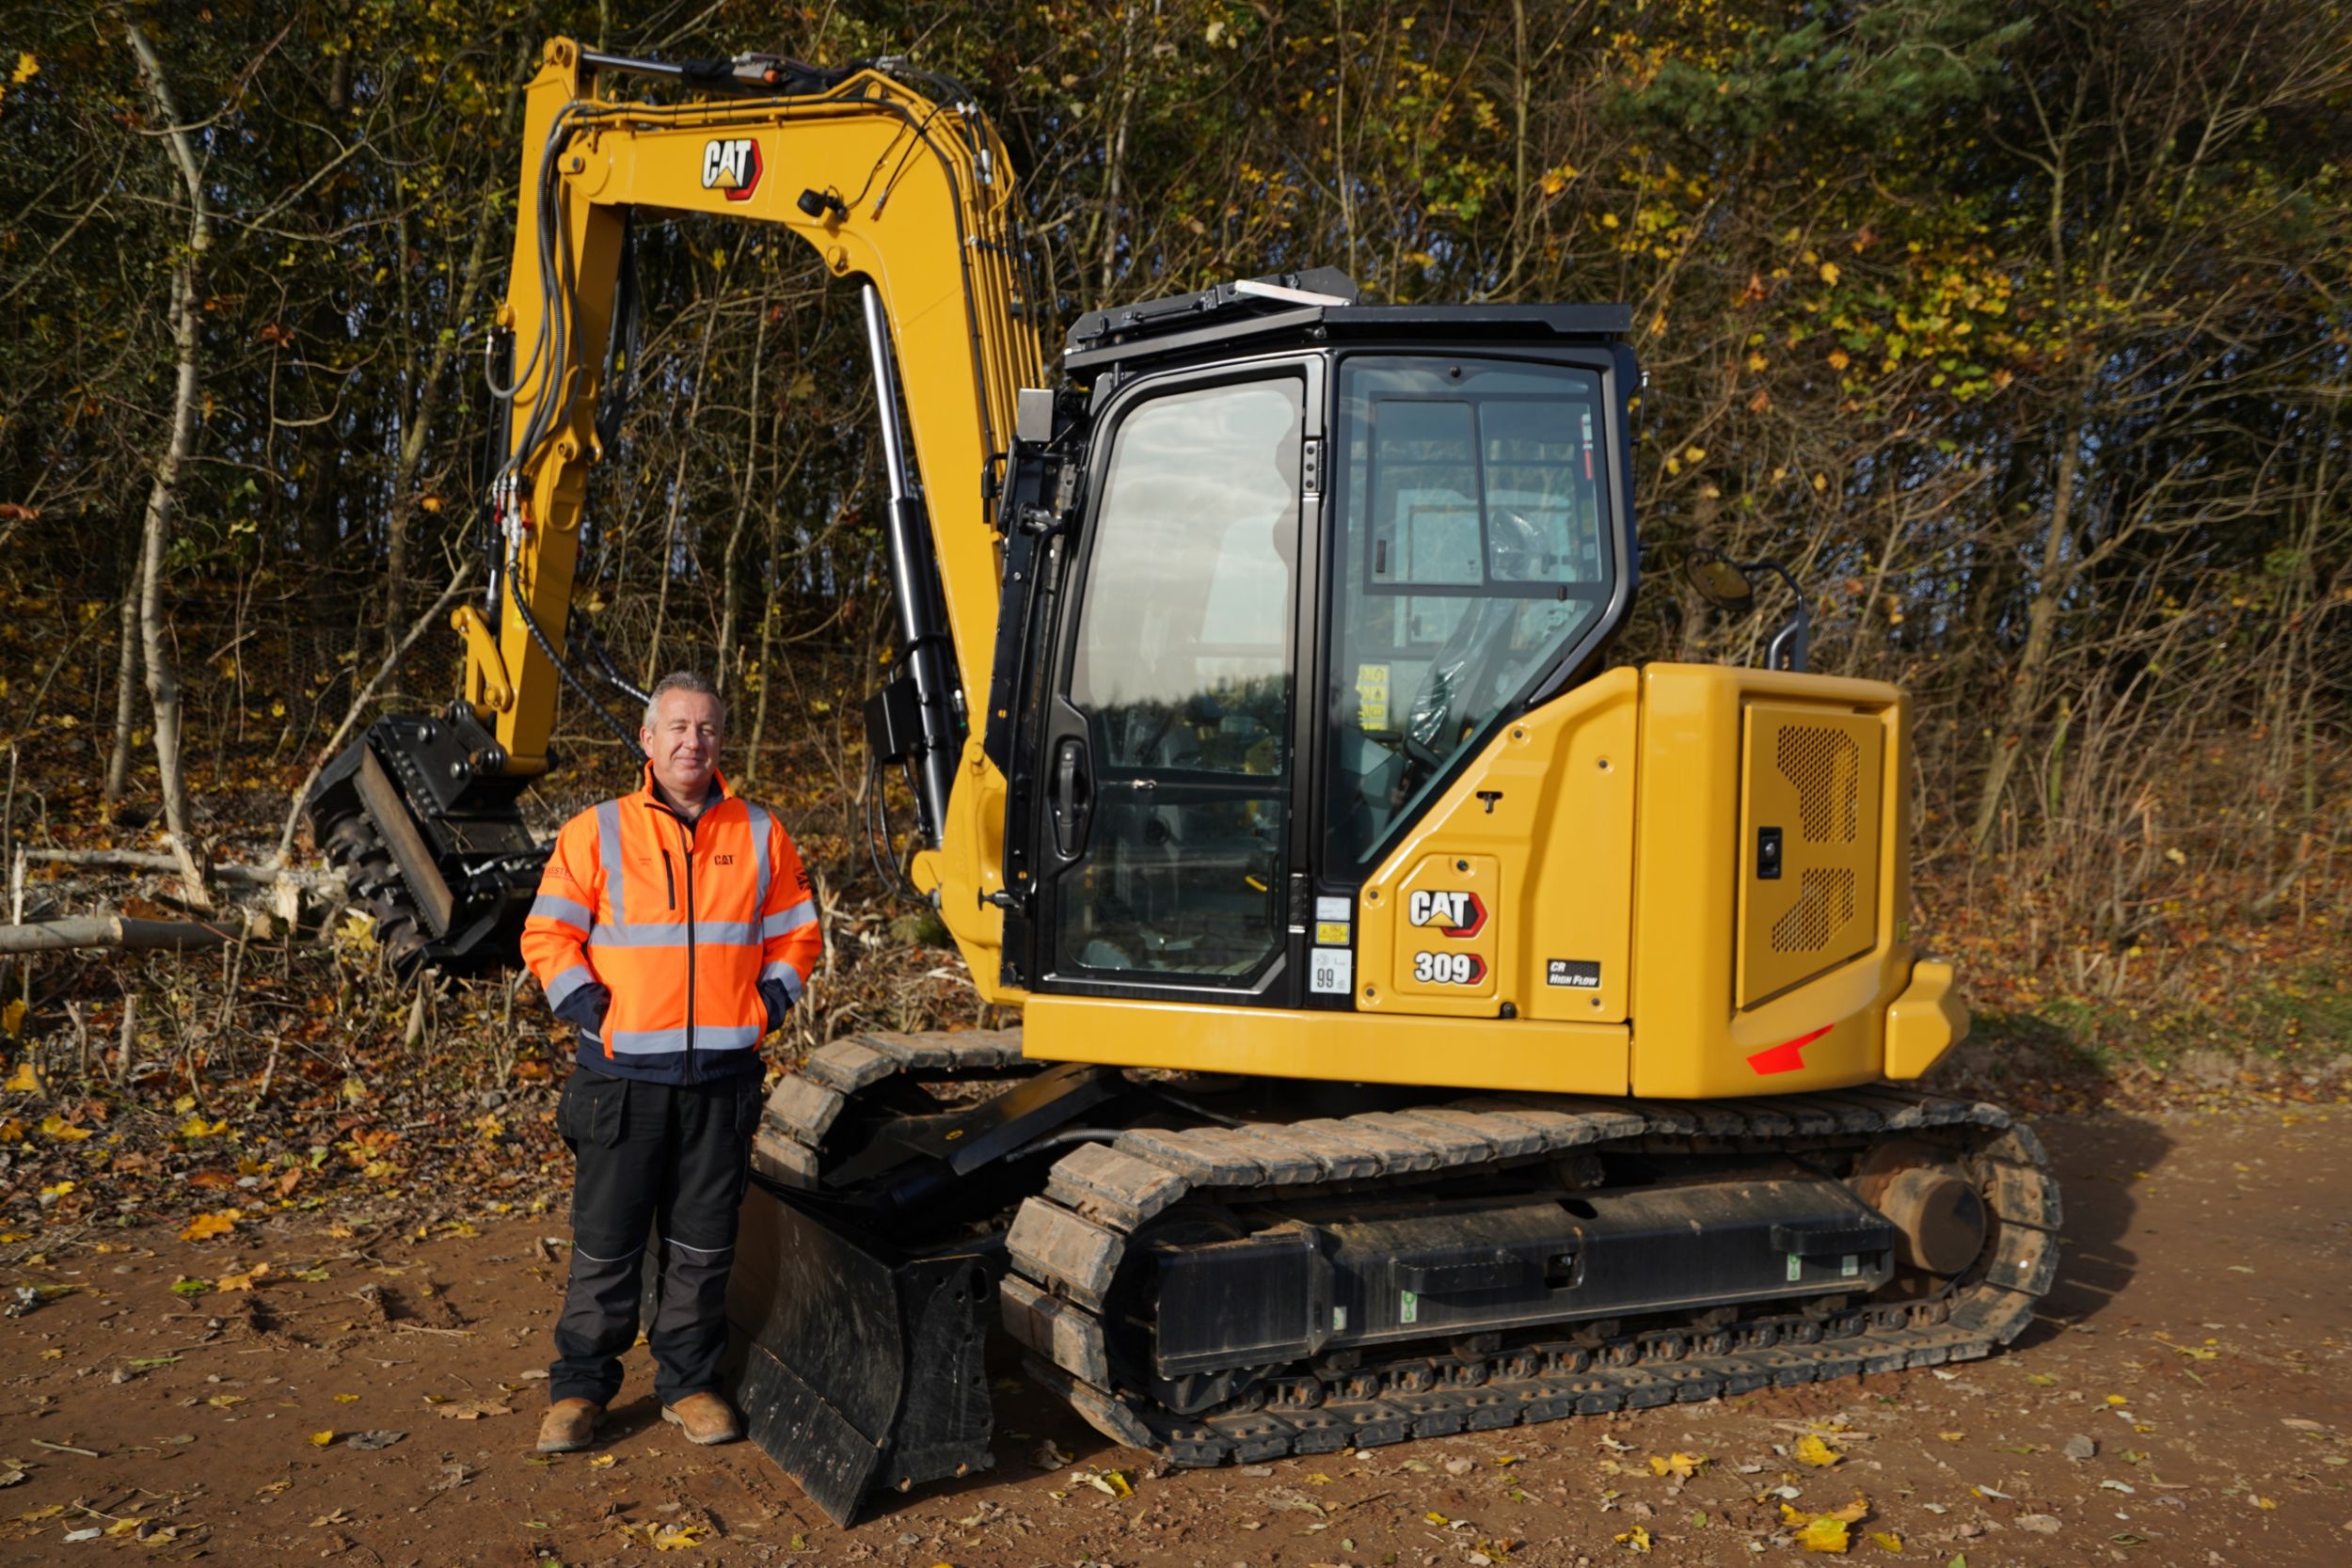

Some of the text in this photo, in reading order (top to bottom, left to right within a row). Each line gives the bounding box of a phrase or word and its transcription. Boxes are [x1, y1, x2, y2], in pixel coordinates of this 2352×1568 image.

[702, 139, 752, 188] CAT
[714, 854, 734, 865] CAT
[1410, 890, 1470, 927] CAT
[1317, 968, 1334, 988] 99
[1414, 951, 1471, 983] 309
[1550, 961, 1566, 973] CR
